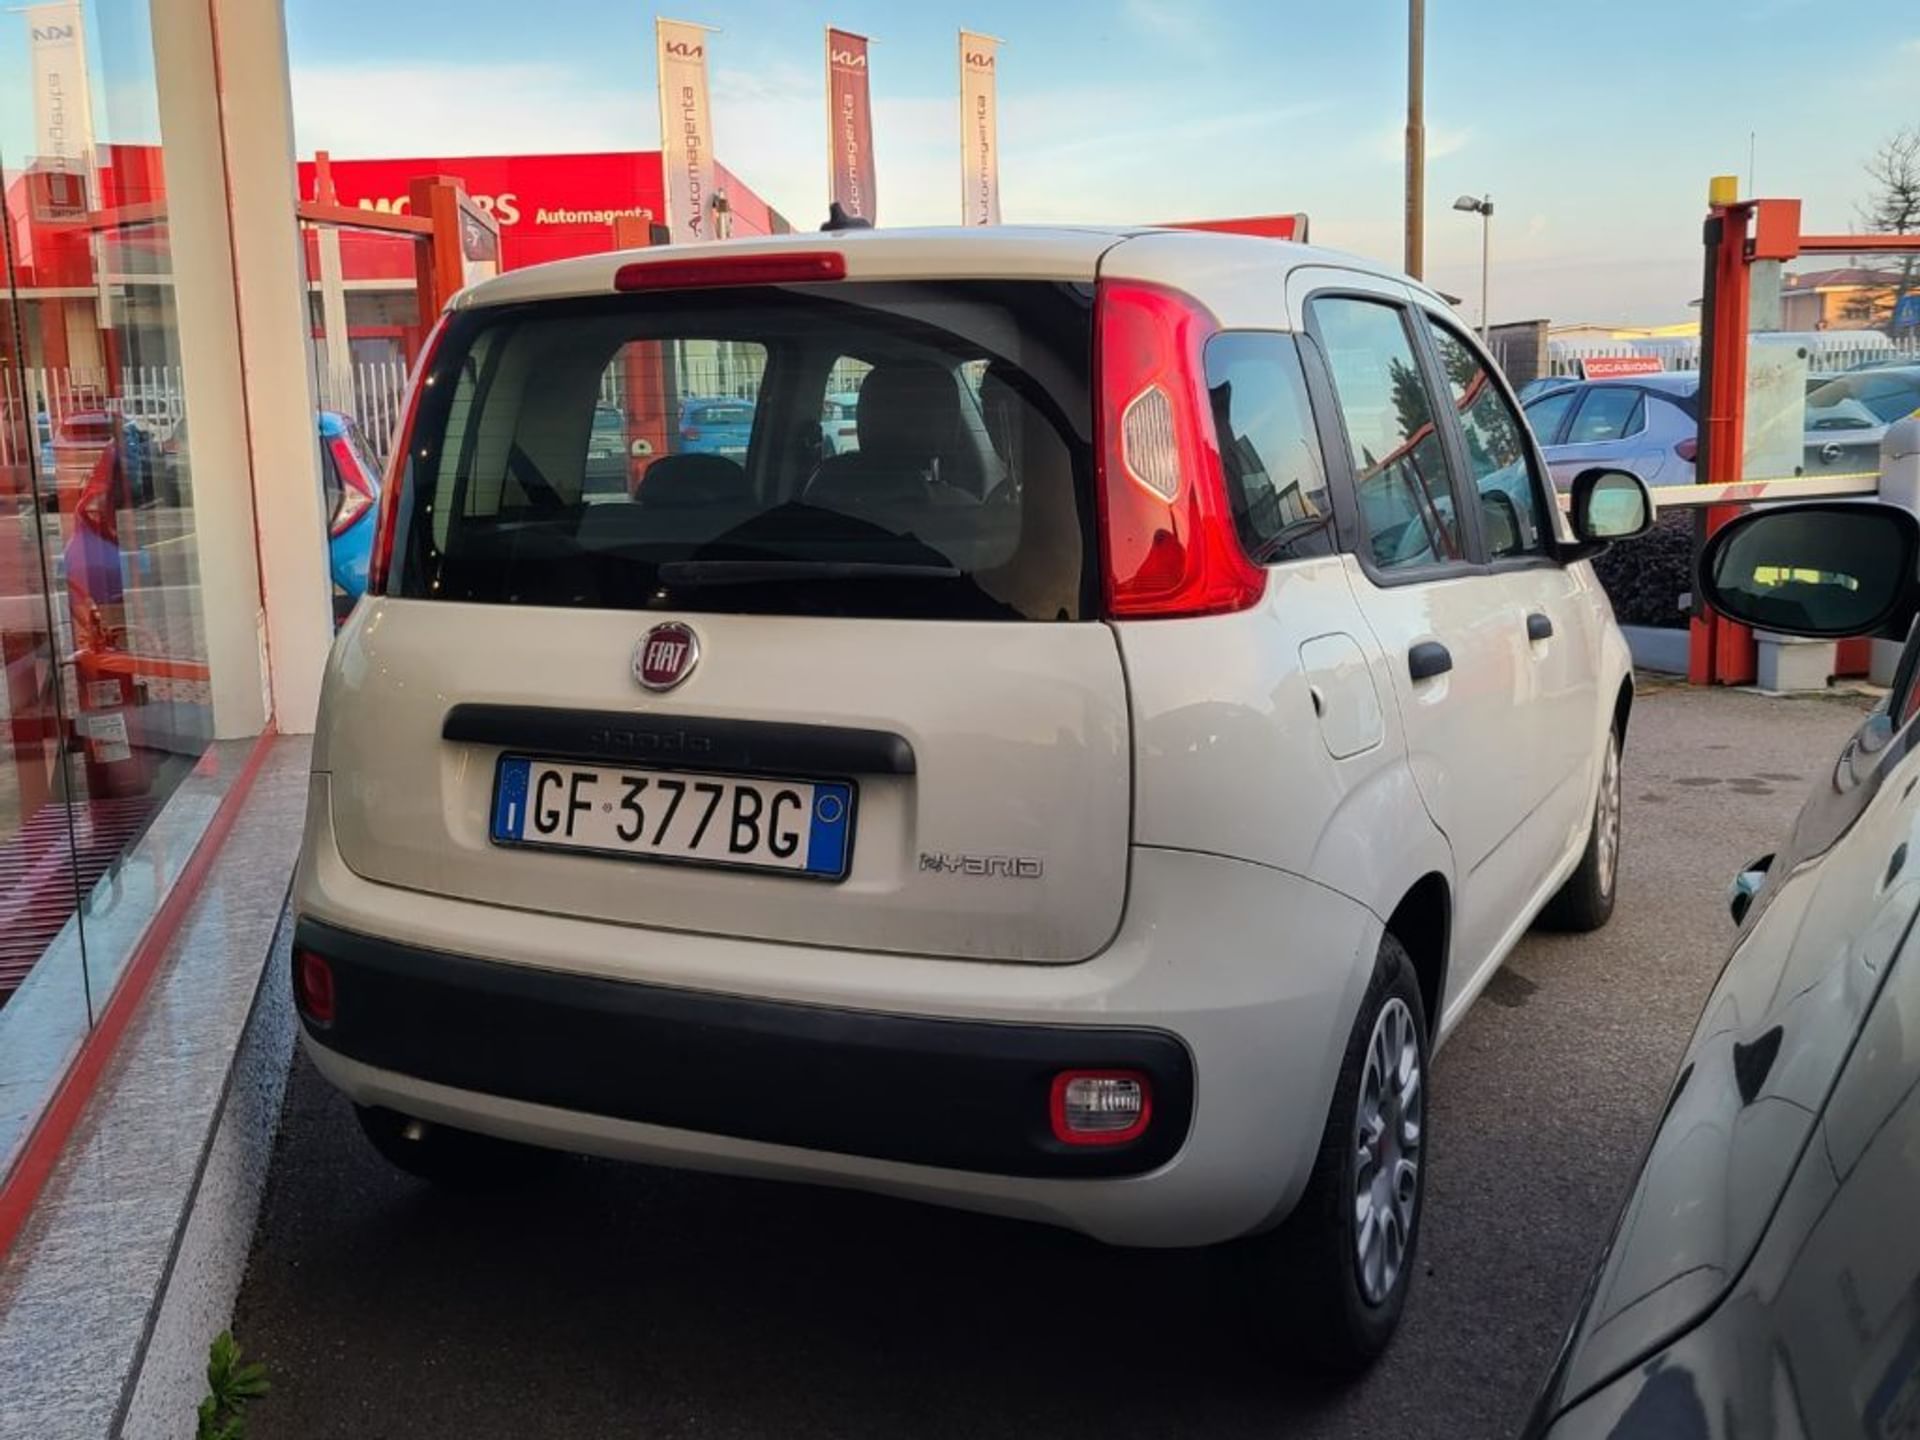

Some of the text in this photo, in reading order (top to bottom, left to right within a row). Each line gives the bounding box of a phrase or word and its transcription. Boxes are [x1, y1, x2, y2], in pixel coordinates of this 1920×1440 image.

[666, 41, 702, 58] KIA
[832, 49, 866, 66] KIA
[966, 52, 994, 68] KIA
[682, 86, 702, 236] Automagenta
[842, 93, 862, 217] utomagenta
[645, 640, 687, 673] FIAT
